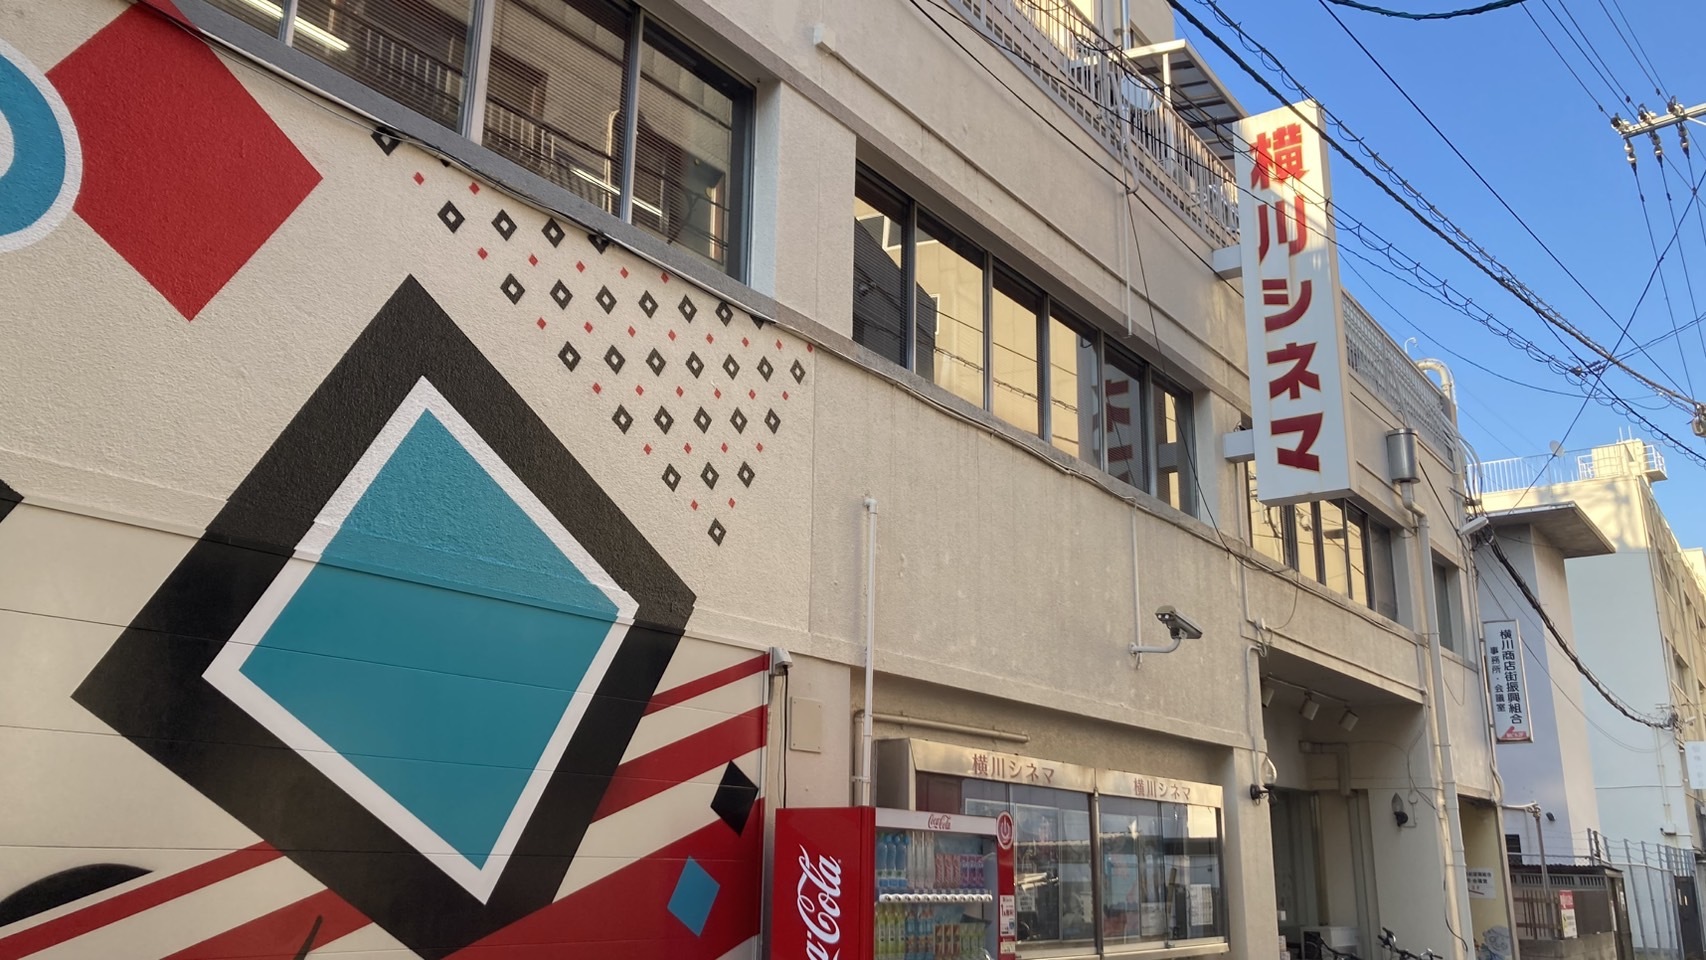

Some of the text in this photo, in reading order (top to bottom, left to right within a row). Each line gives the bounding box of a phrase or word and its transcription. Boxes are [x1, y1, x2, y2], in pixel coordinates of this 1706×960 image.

[1250, 122, 1323, 473] 横川シネマ
[1500, 629, 1523, 724] 横川商店街振興組合
[972, 753, 1055, 784] 横川シネマ
[1134, 777, 1191, 800] 横川シネマ
